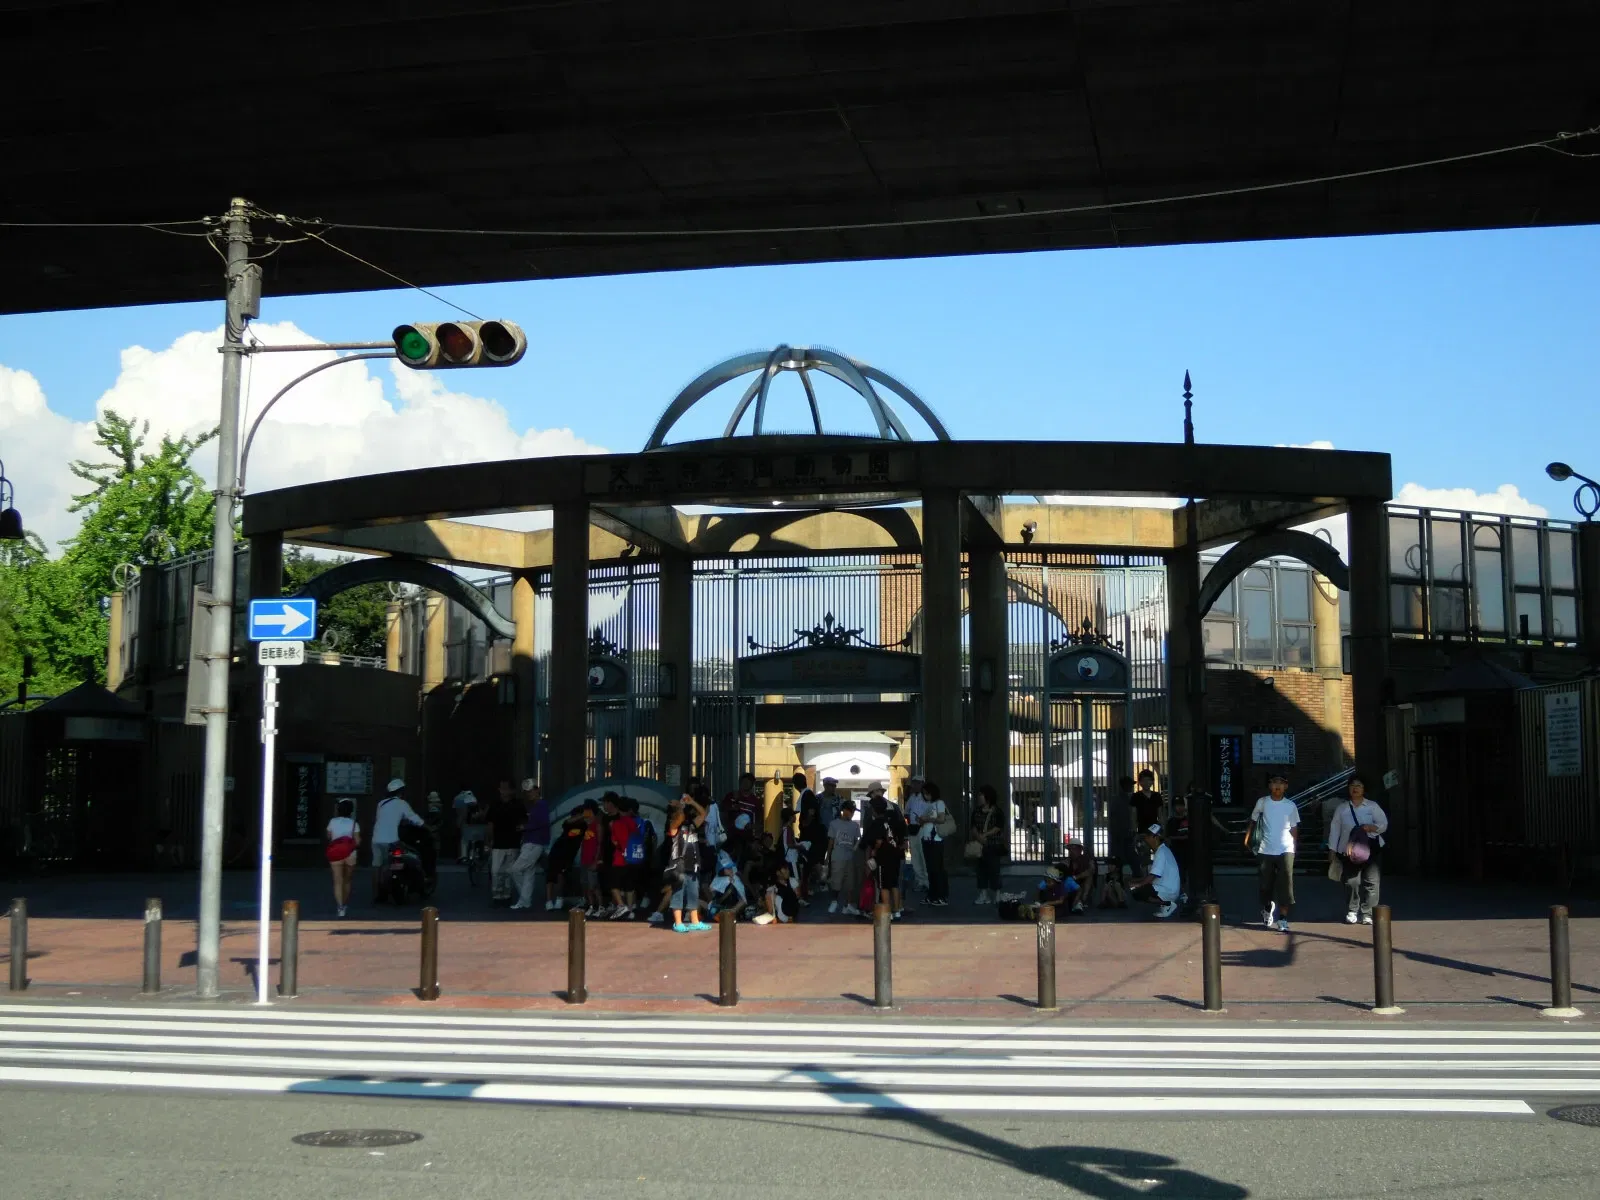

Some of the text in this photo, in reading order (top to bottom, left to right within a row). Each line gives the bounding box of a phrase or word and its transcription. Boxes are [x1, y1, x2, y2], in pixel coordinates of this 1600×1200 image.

[261, 646, 301, 660] 自転車を除く
